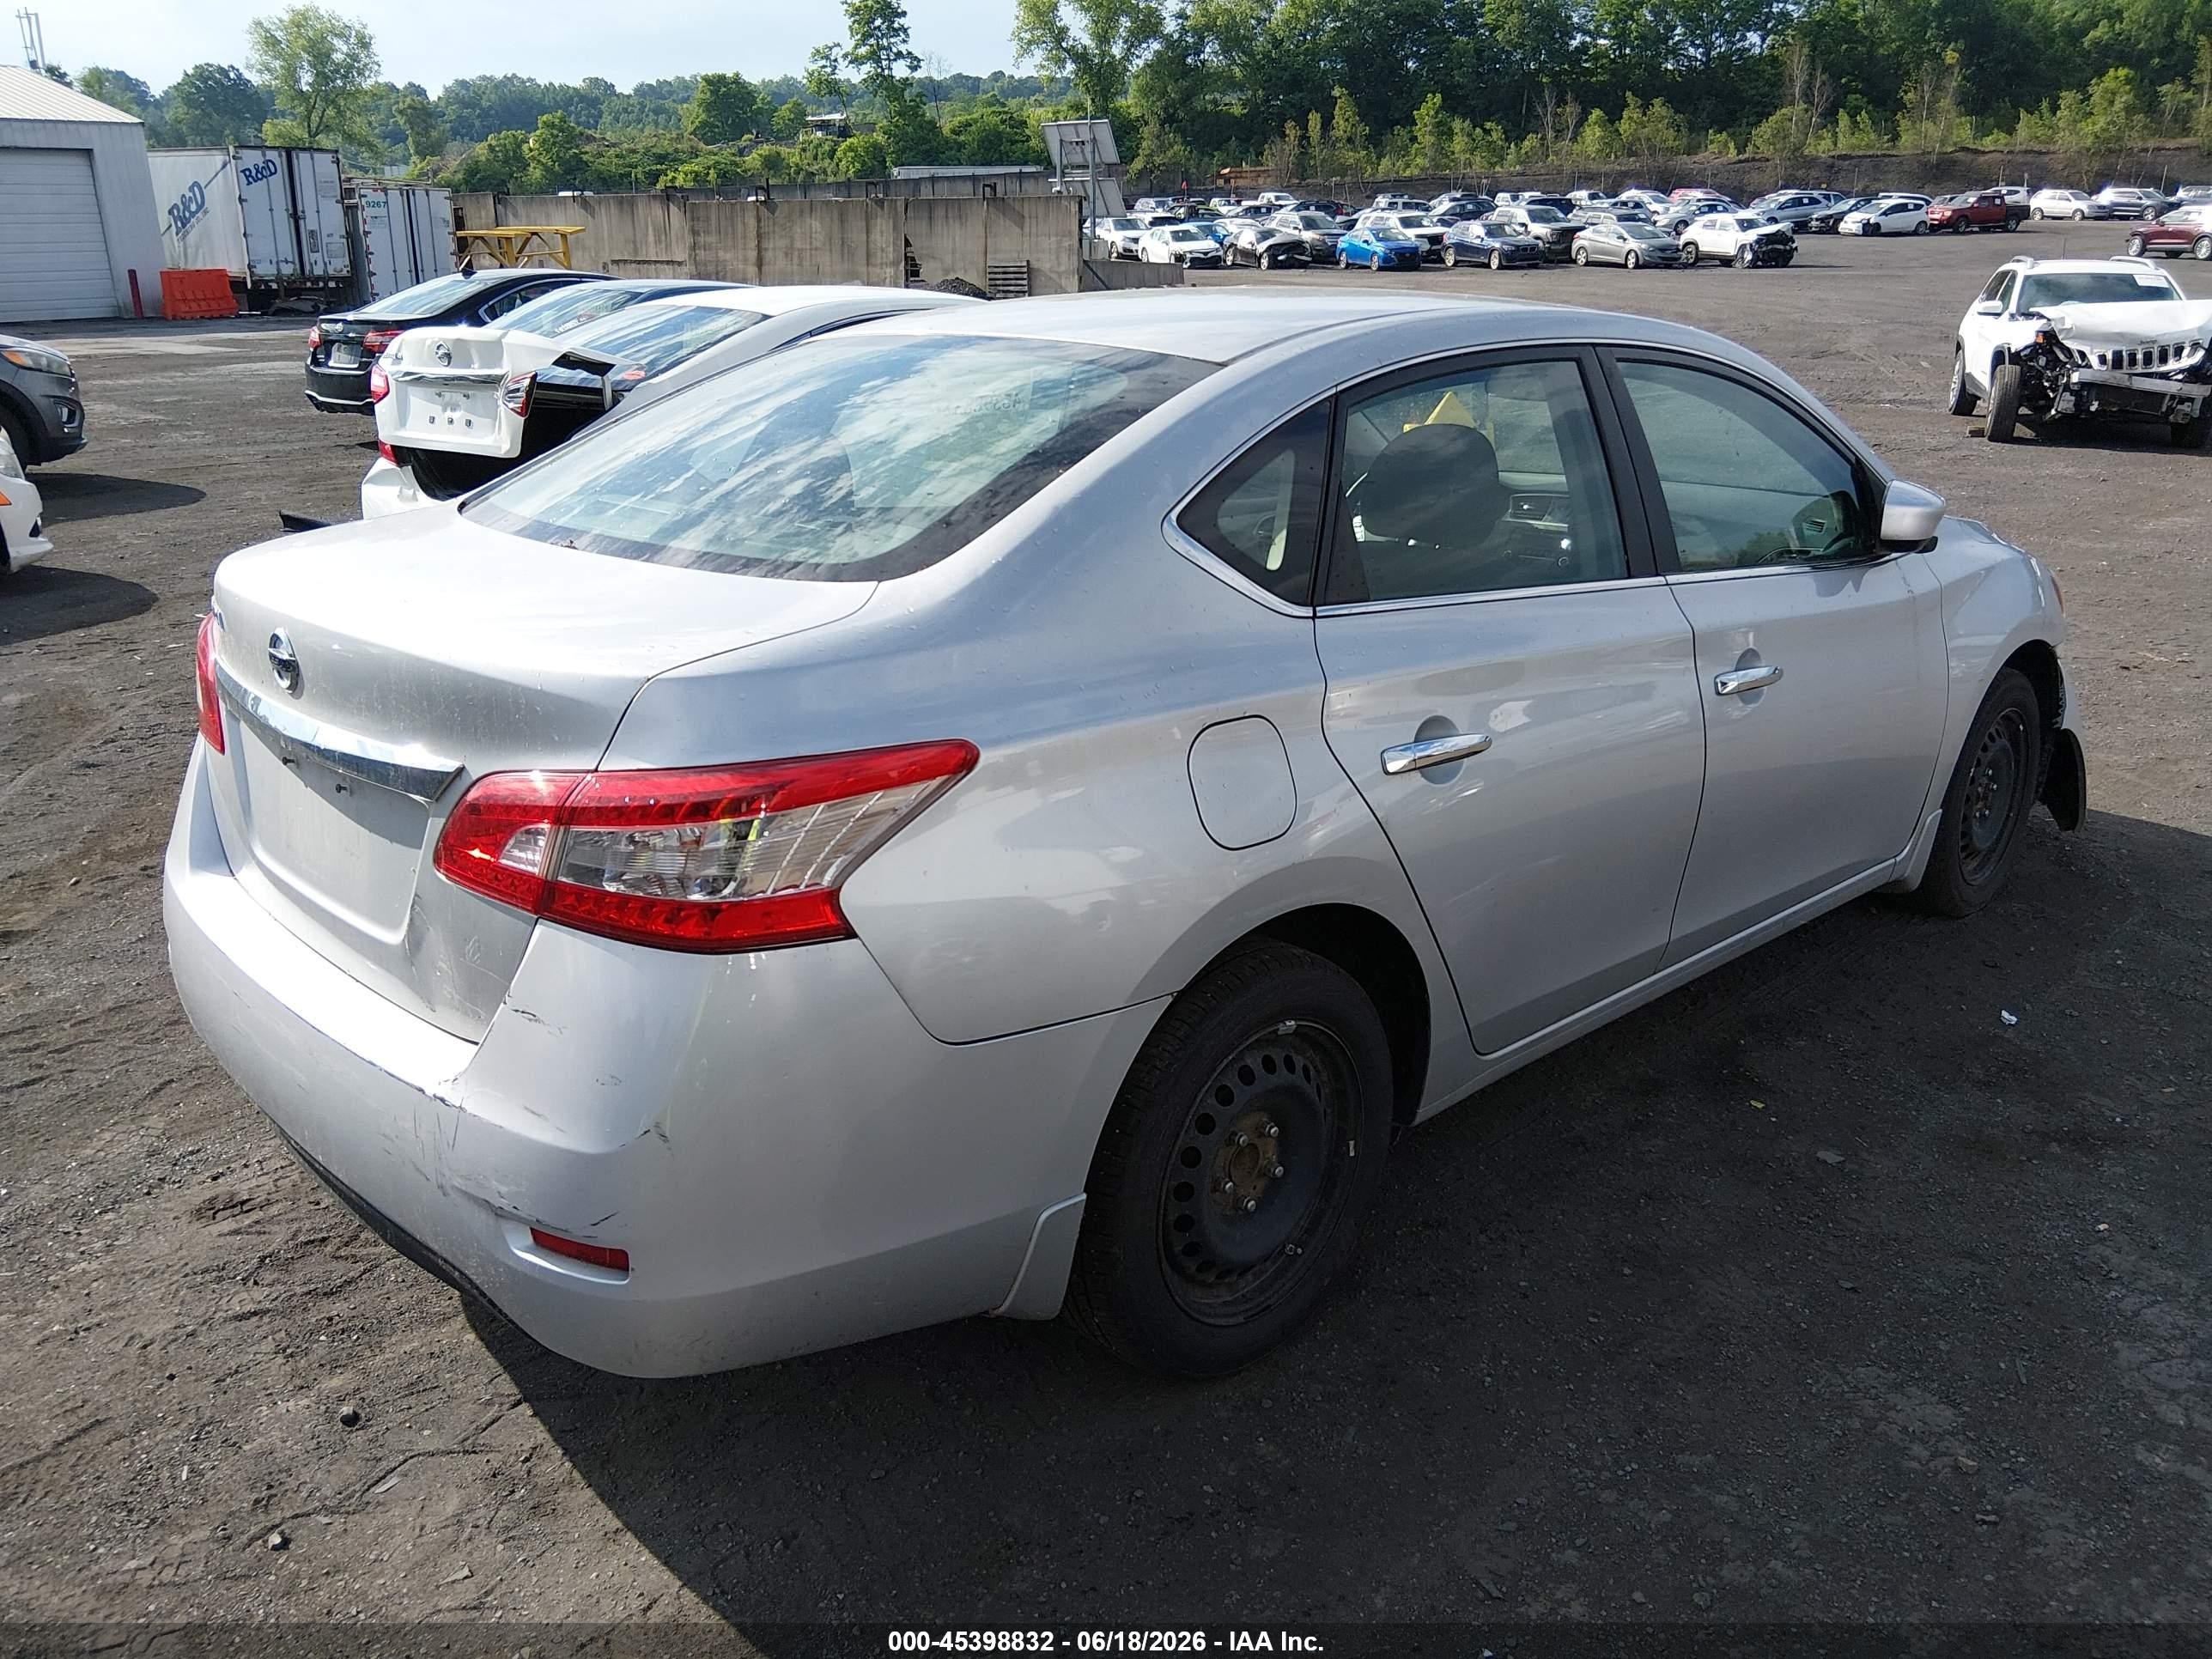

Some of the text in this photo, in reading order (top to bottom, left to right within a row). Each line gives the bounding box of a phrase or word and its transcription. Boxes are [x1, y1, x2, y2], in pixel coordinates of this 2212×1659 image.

[240, 159, 277, 185] R&D
[167, 180, 205, 236] R&D
[365, 200, 386, 209] 9267
